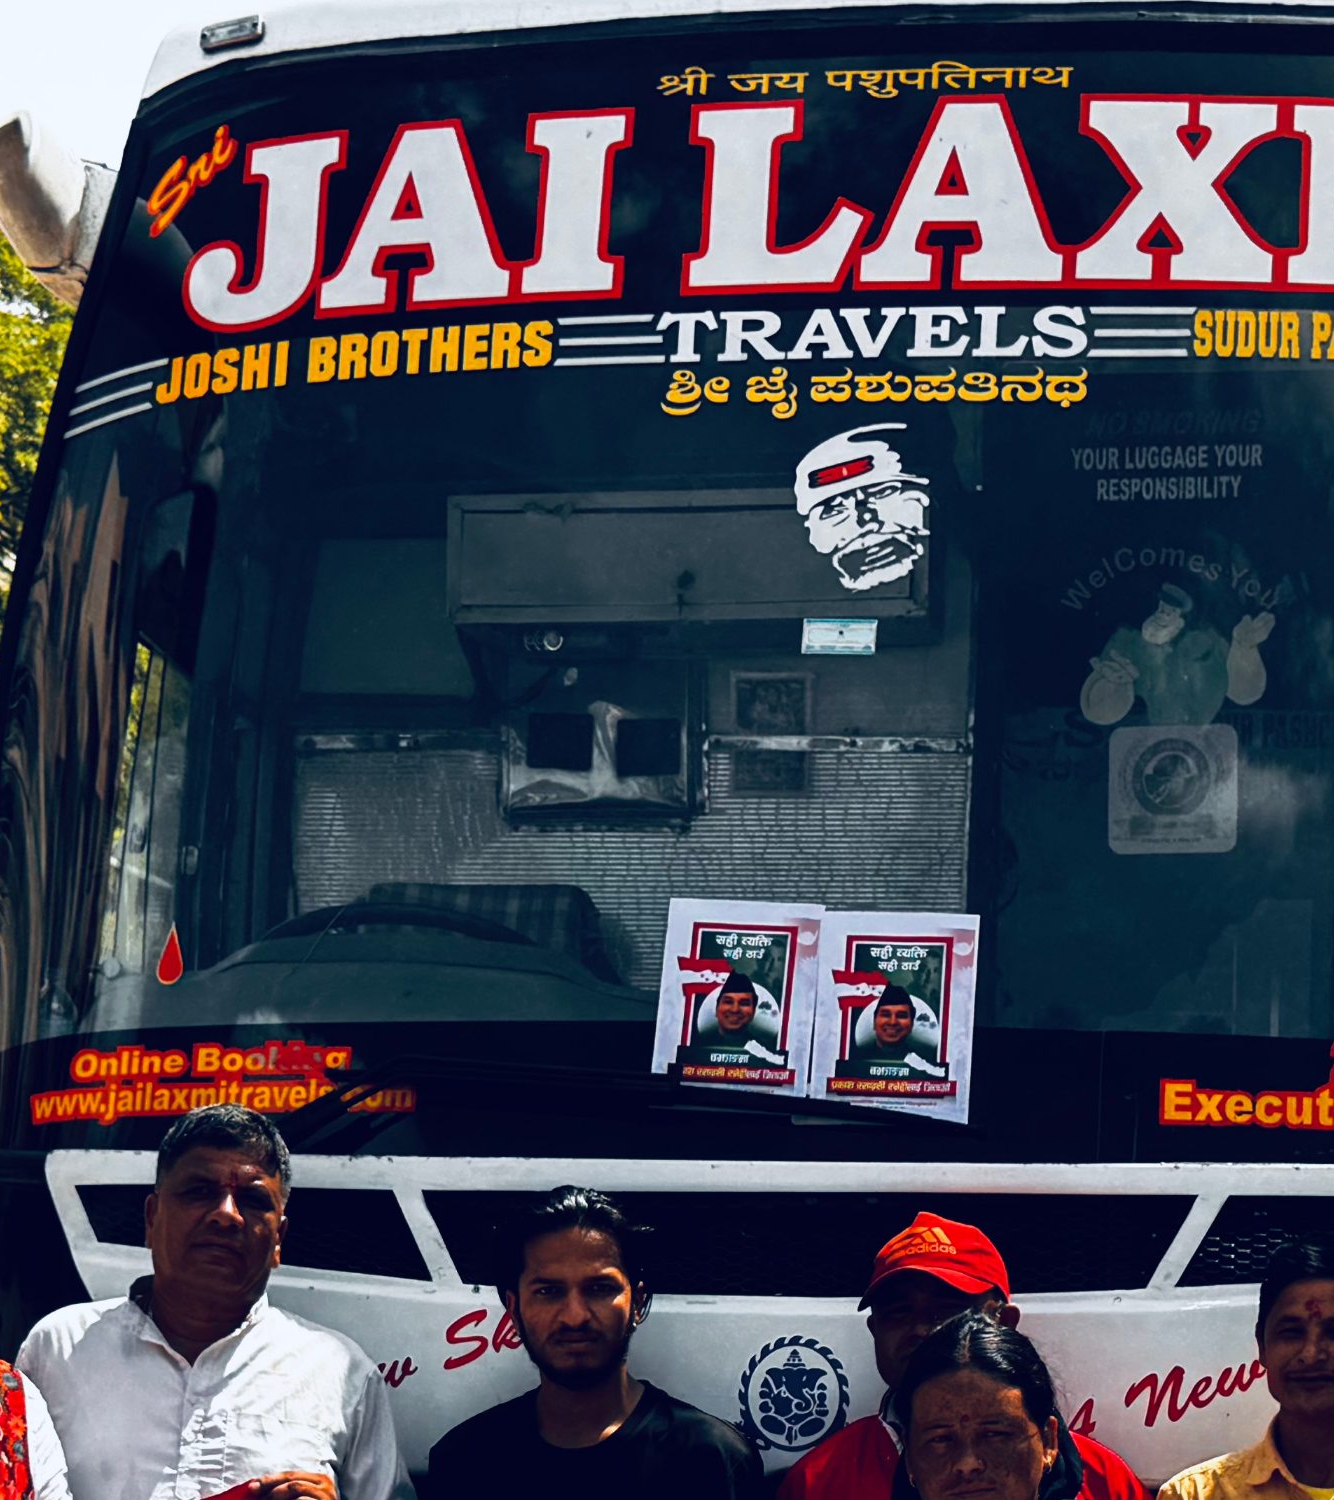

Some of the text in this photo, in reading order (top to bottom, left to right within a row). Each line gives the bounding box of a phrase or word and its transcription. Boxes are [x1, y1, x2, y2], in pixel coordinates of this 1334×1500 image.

[656, 61, 1074, 98] श्री जय पशुपतिनाथ
[146, 125, 237, 237] Sri
[182, 107, 635, 332] JAI
[656, 306, 1089, 363] TRAVELS
[1193, 310, 1299, 361] SUDUR
[156, 321, 554, 404] JOSHI BROTHERS
[1071, 444, 1263, 470] YOUR LUGGAGE YOUR
[1097, 475, 1242, 501] RESPONSIBILITY
[72, 1046, 186, 1081] Online
[906, 1242, 957, 1255] adidas
[1124, 1359, 1266, 1427] New
